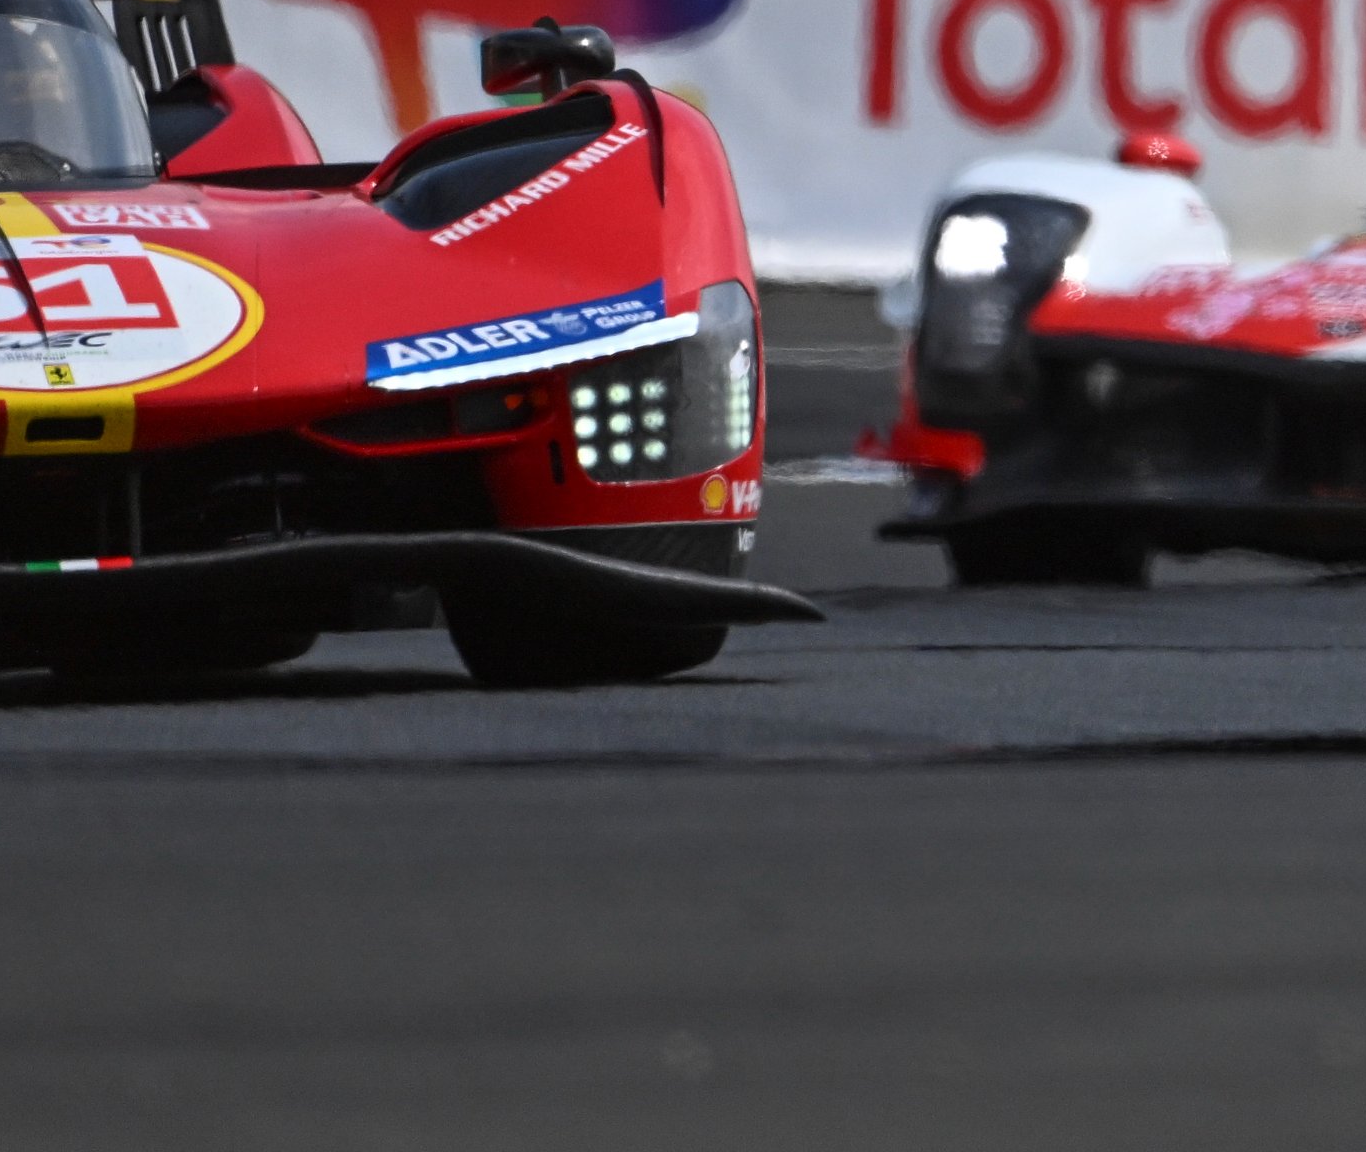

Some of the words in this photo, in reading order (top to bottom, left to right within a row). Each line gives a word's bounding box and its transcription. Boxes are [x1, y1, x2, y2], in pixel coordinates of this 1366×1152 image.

[430, 169, 572, 247] RICHARD
[565, 122, 649, 175] MILLE
[580, 300, 646, 320] PELZER
[595, 309, 657, 330] GROUP
[383, 318, 552, 370] ADLER
